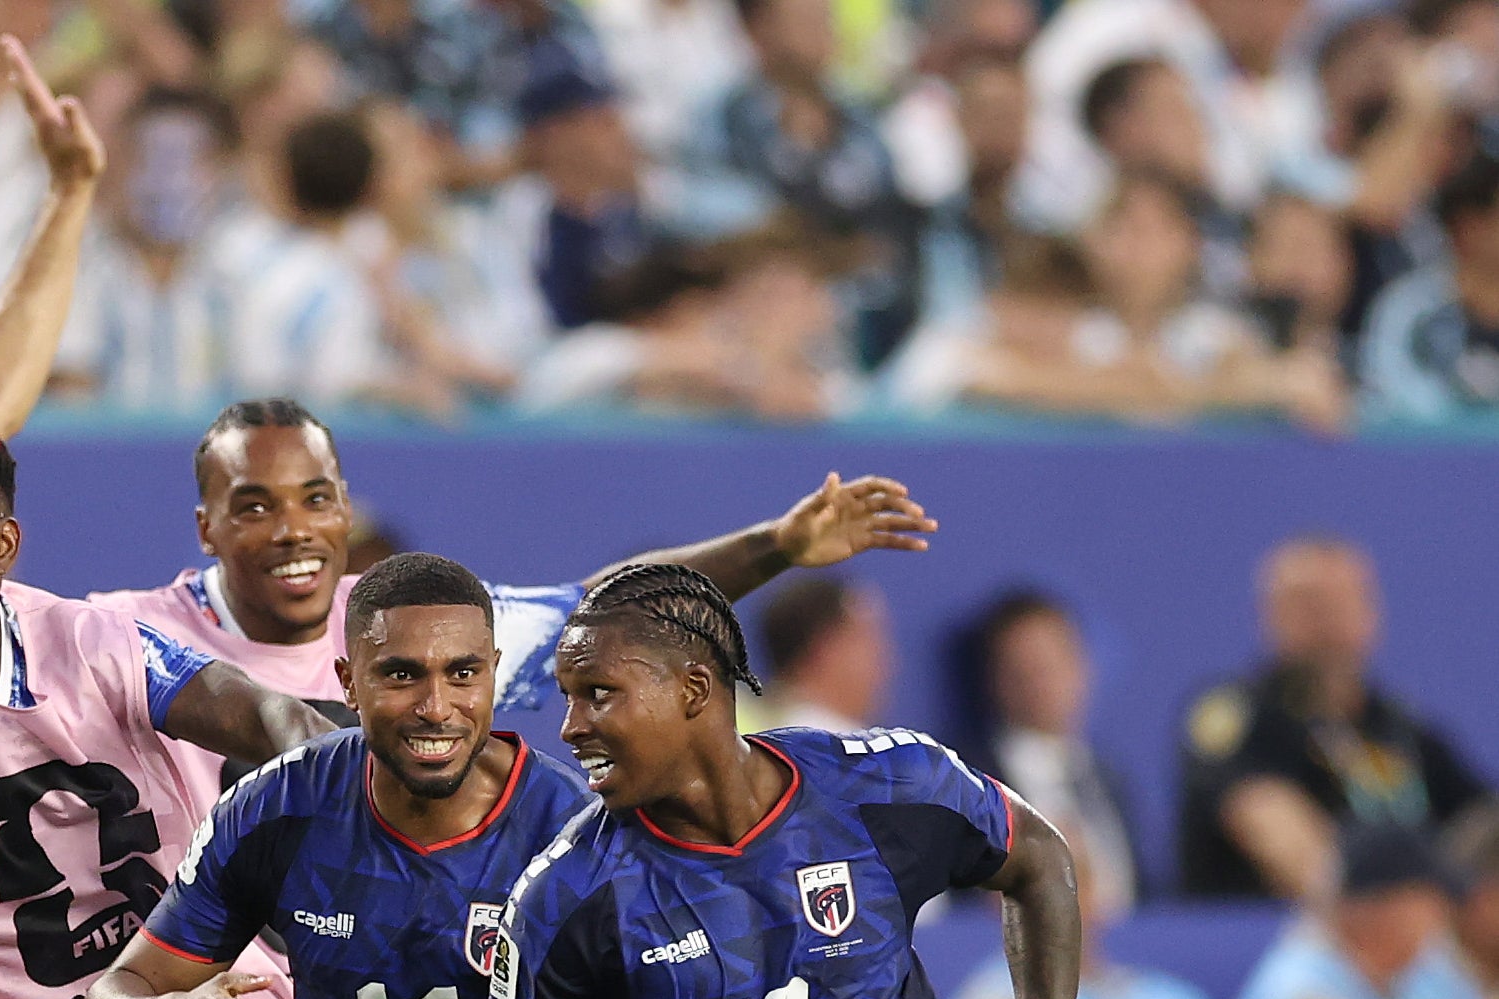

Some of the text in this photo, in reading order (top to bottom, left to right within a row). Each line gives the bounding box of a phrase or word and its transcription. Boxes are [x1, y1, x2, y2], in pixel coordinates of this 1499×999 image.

[803, 866, 844, 884] FCF
[293, 909, 355, 934] capelli
[474, 908, 503, 920] FC
[72, 911, 145, 959] FIFA
[317, 927, 353, 940] SPORT
[641, 929, 710, 964] capelli
[675, 946, 711, 964] SPORT
